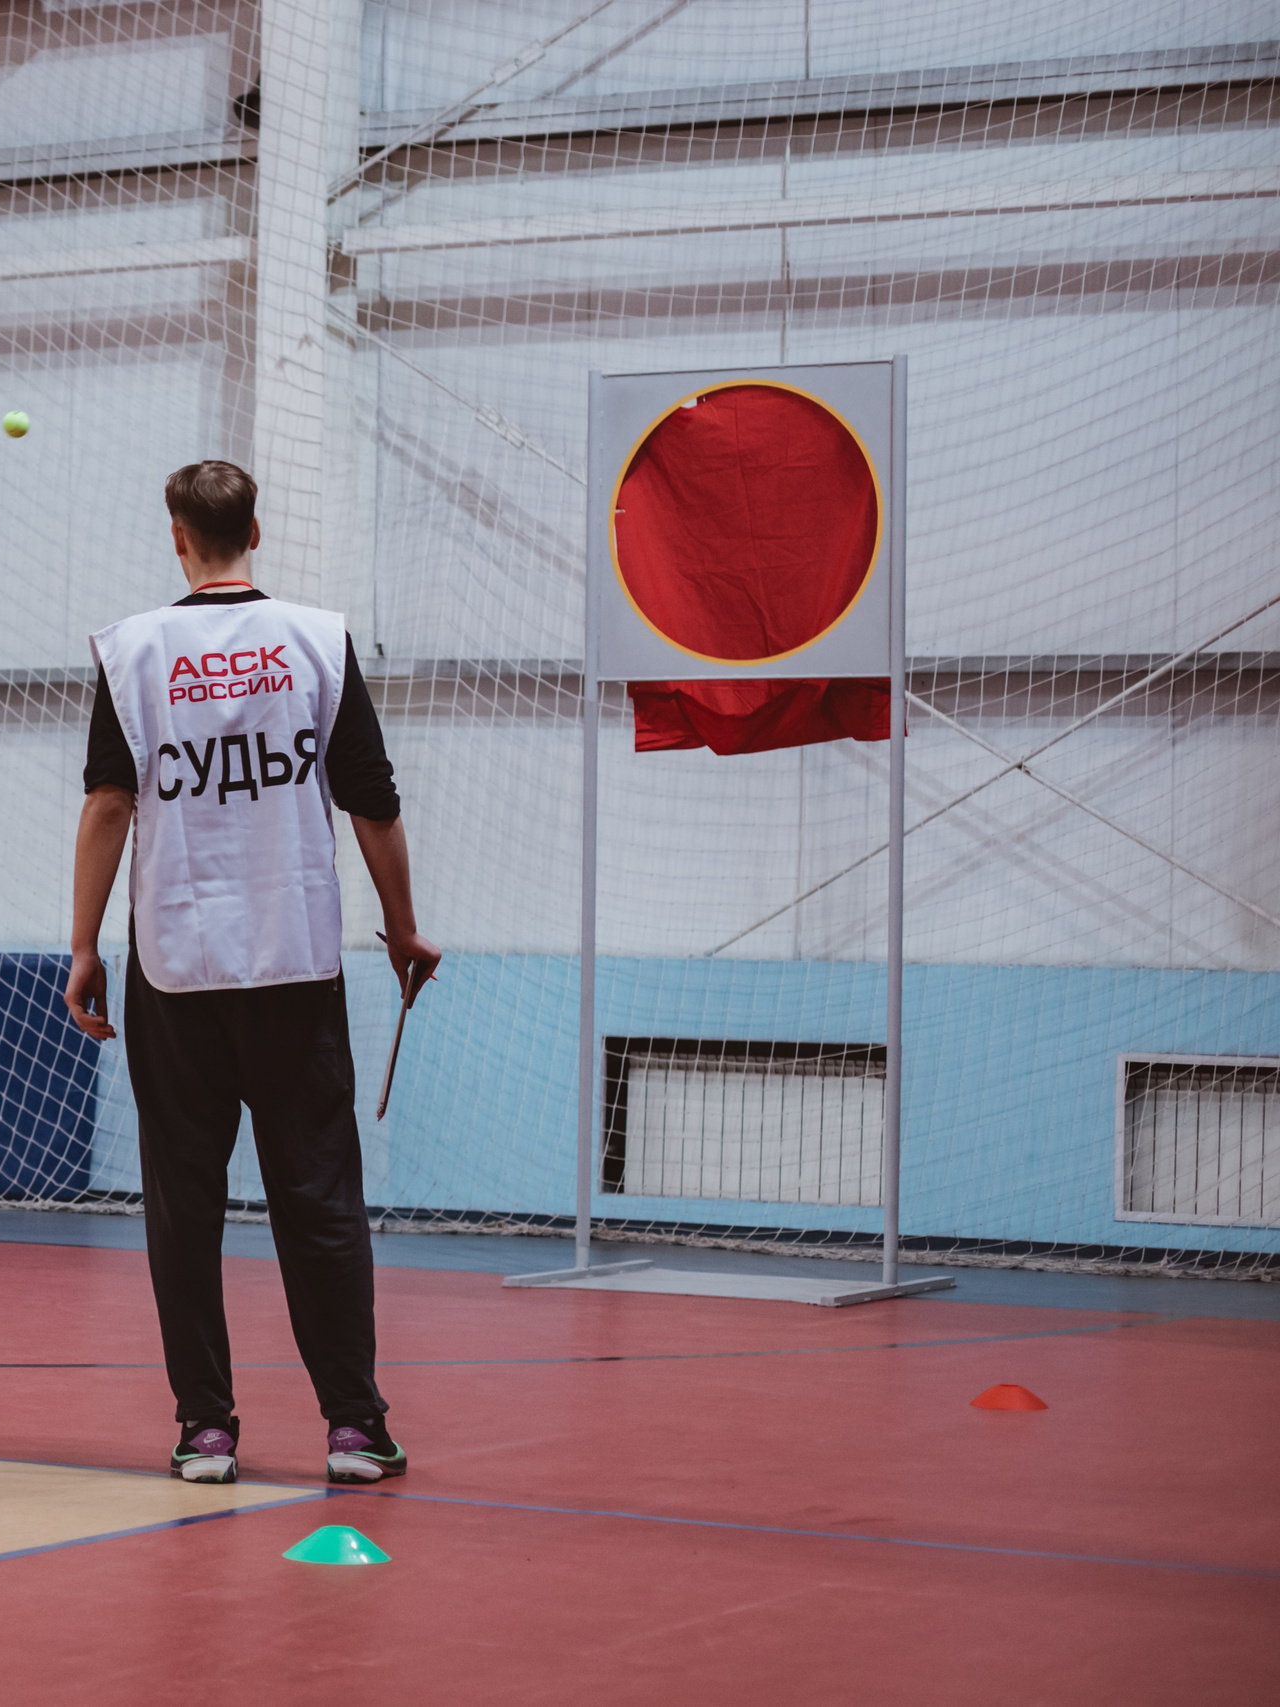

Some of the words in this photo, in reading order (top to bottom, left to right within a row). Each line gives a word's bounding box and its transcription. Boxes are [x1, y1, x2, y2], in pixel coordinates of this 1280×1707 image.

[169, 645, 290, 683] АССК
[169, 674, 293, 705] РОССИИ
[158, 728, 318, 805] СУДЬЯ
